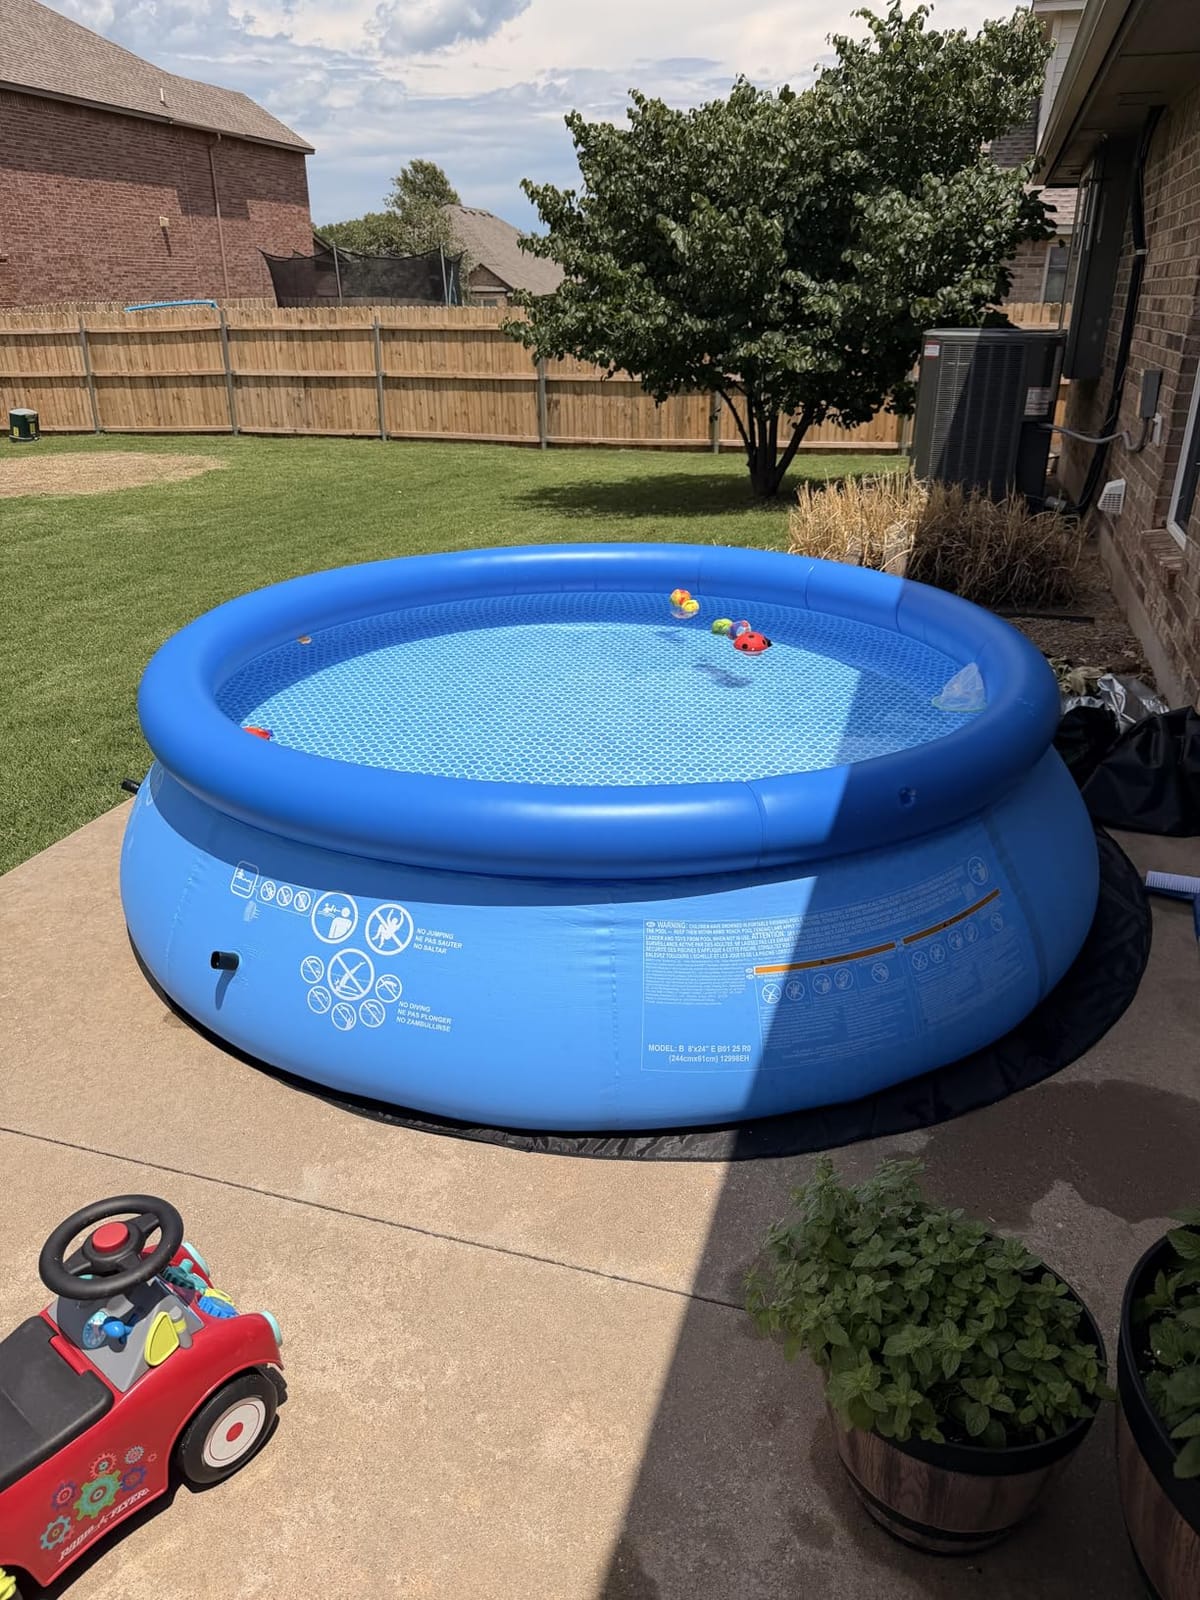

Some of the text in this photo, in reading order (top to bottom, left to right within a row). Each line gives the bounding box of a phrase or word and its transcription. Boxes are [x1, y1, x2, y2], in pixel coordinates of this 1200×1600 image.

[427, 930, 454, 940] JUMPING
[415, 935, 463, 950] NE PAS SAUTER
[423, 945, 447, 954] SALTAR
[409, 1003, 431, 1012] DIVING
[407, 1011, 420, 1019] PAS
[421, 1013, 452, 1024] PLONGER
[648, 1044, 677, 1052] MODEL:
